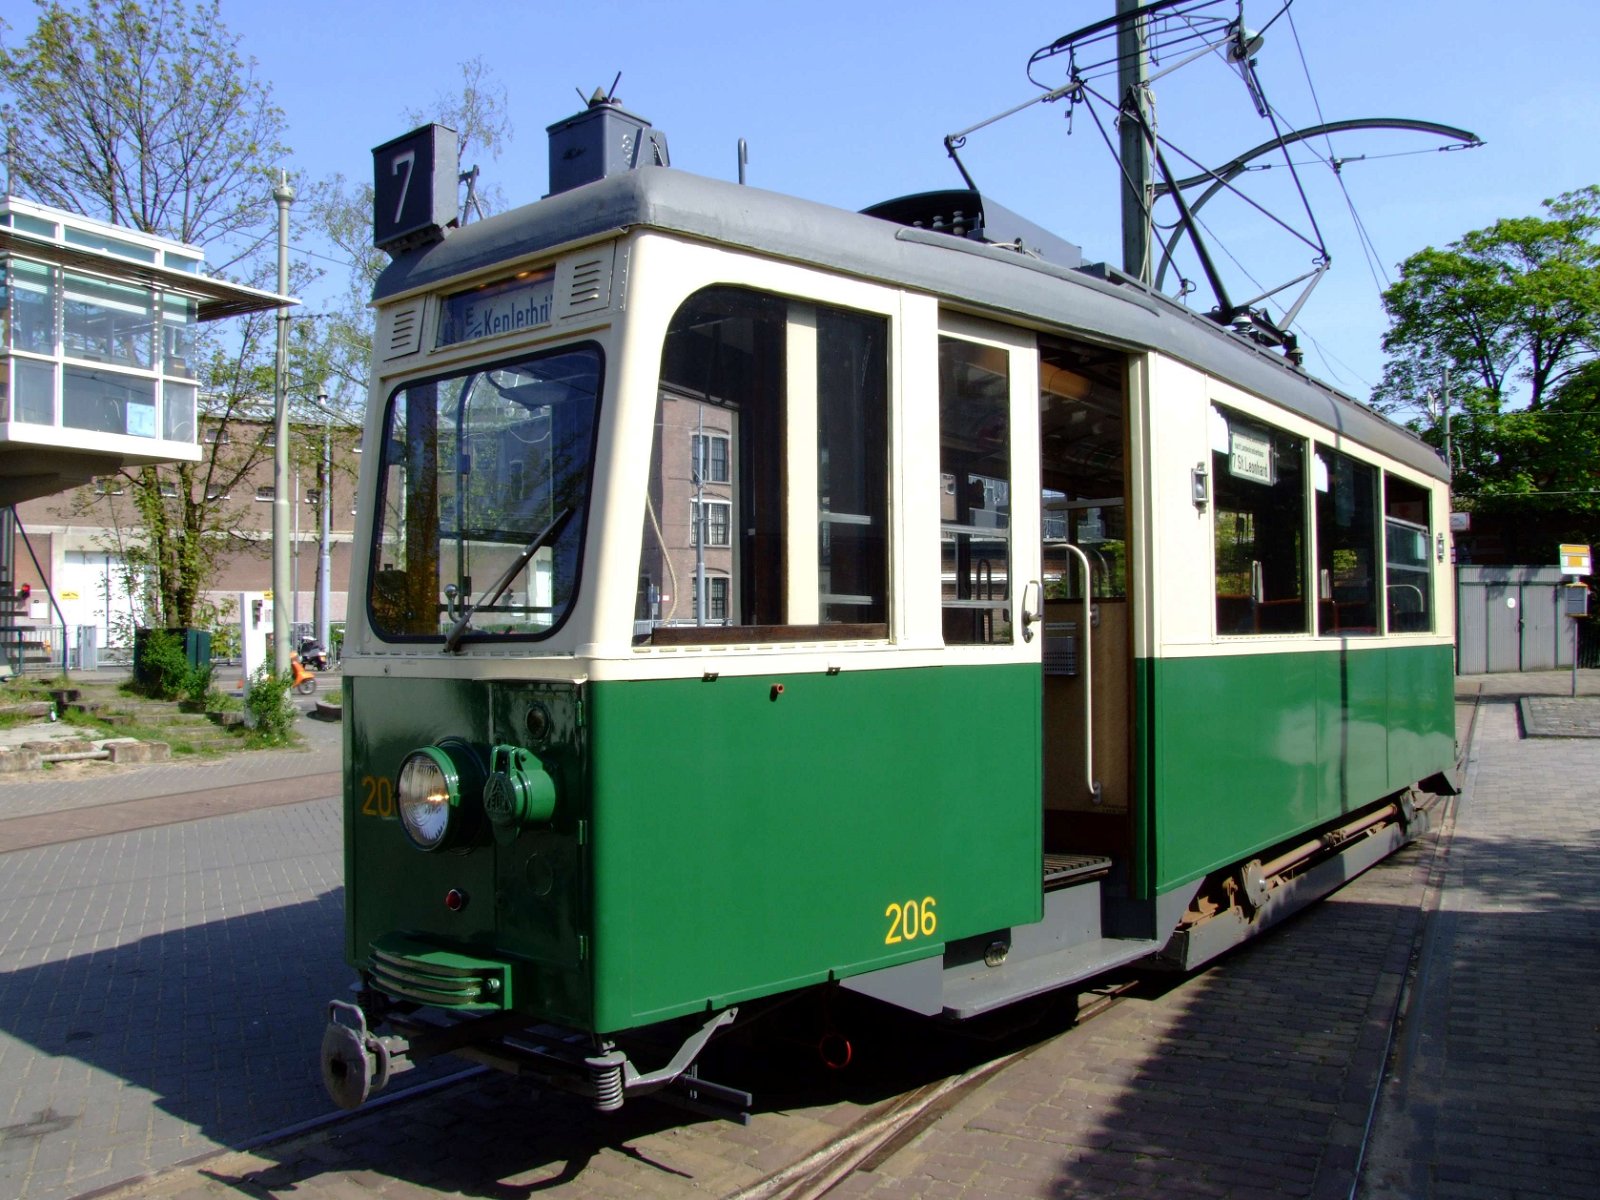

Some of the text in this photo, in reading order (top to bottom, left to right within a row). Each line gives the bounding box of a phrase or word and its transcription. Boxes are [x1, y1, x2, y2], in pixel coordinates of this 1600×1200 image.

[391, 150, 416, 224] 7
[361, 775, 398, 817] 20
[884, 895, 937, 945] 206
